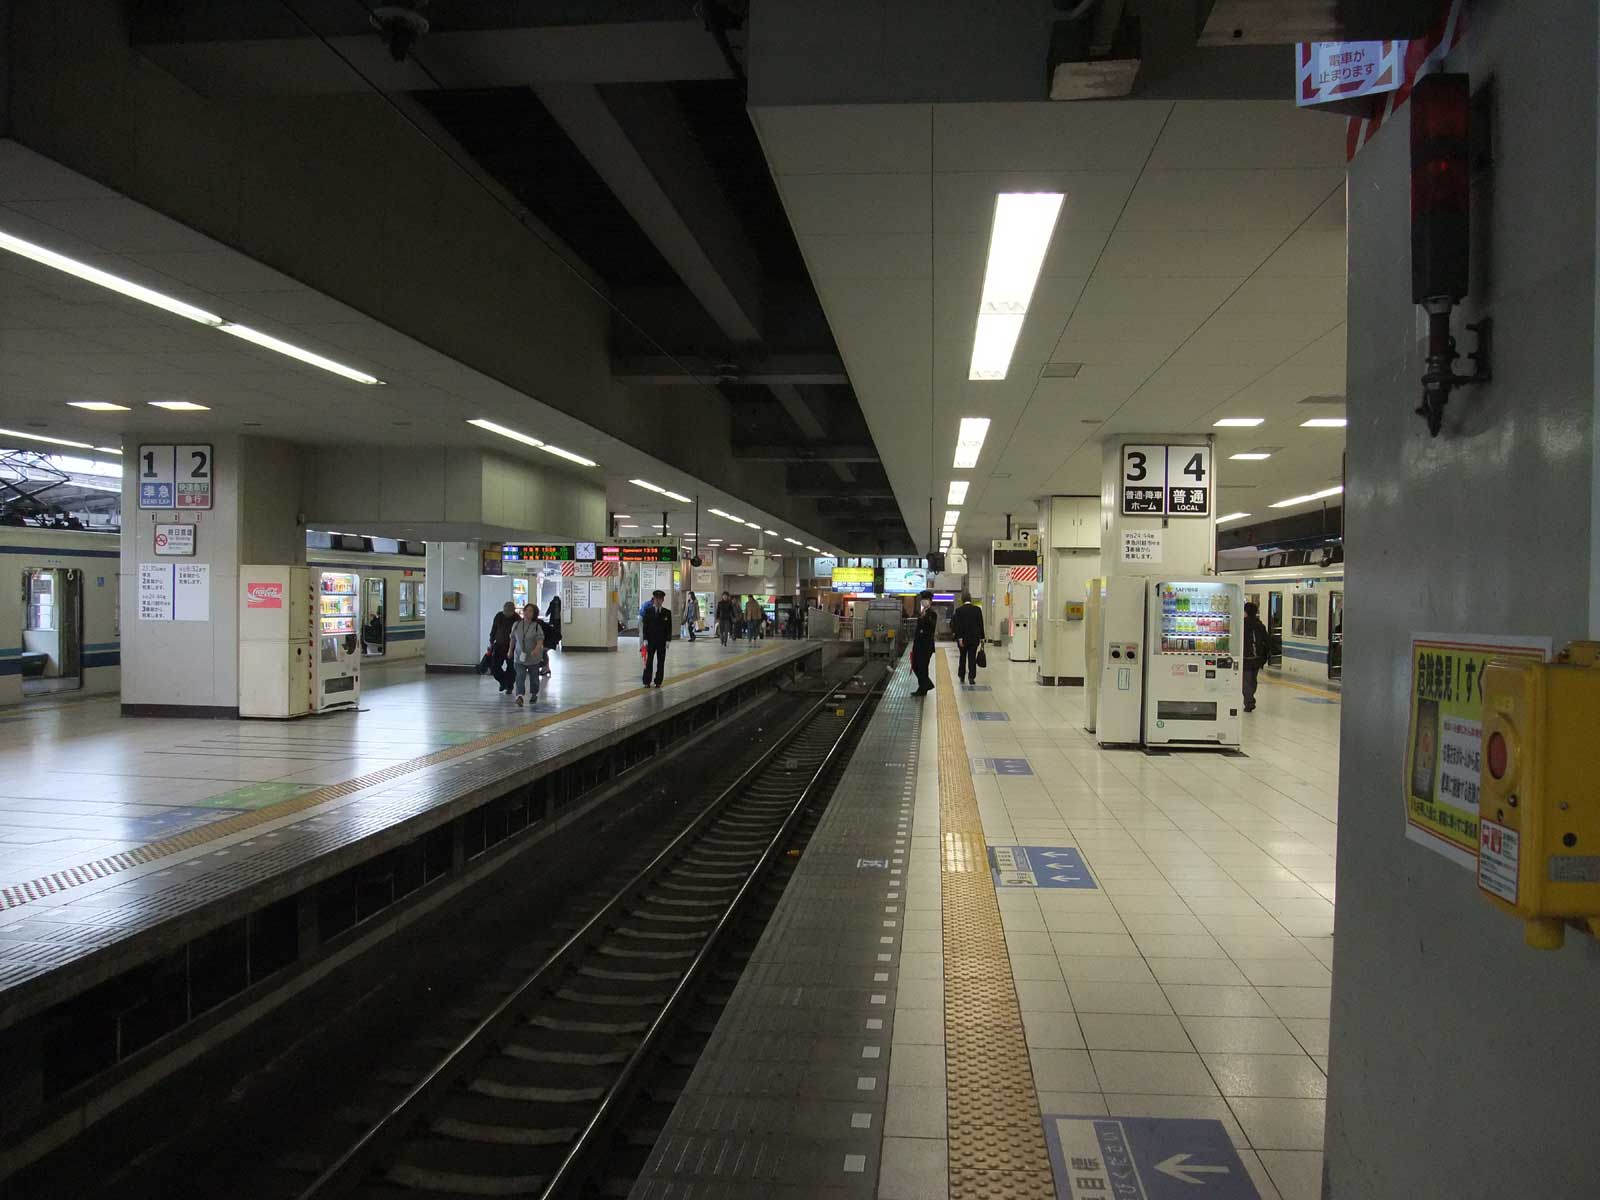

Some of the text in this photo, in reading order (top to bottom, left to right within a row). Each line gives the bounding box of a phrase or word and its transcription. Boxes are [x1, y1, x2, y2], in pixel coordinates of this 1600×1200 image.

[1328, 48, 1365, 67] 電車が
[1319, 63, 1375, 84] 止まります
[143, 451, 158, 478] 1
[191, 451, 208, 478] 2
[1126, 451, 1147, 481] 3
[1183, 453, 1206, 482] 4
[1131, 501, 1157, 511] ホーム
[1172, 489, 1204, 504] 普通
